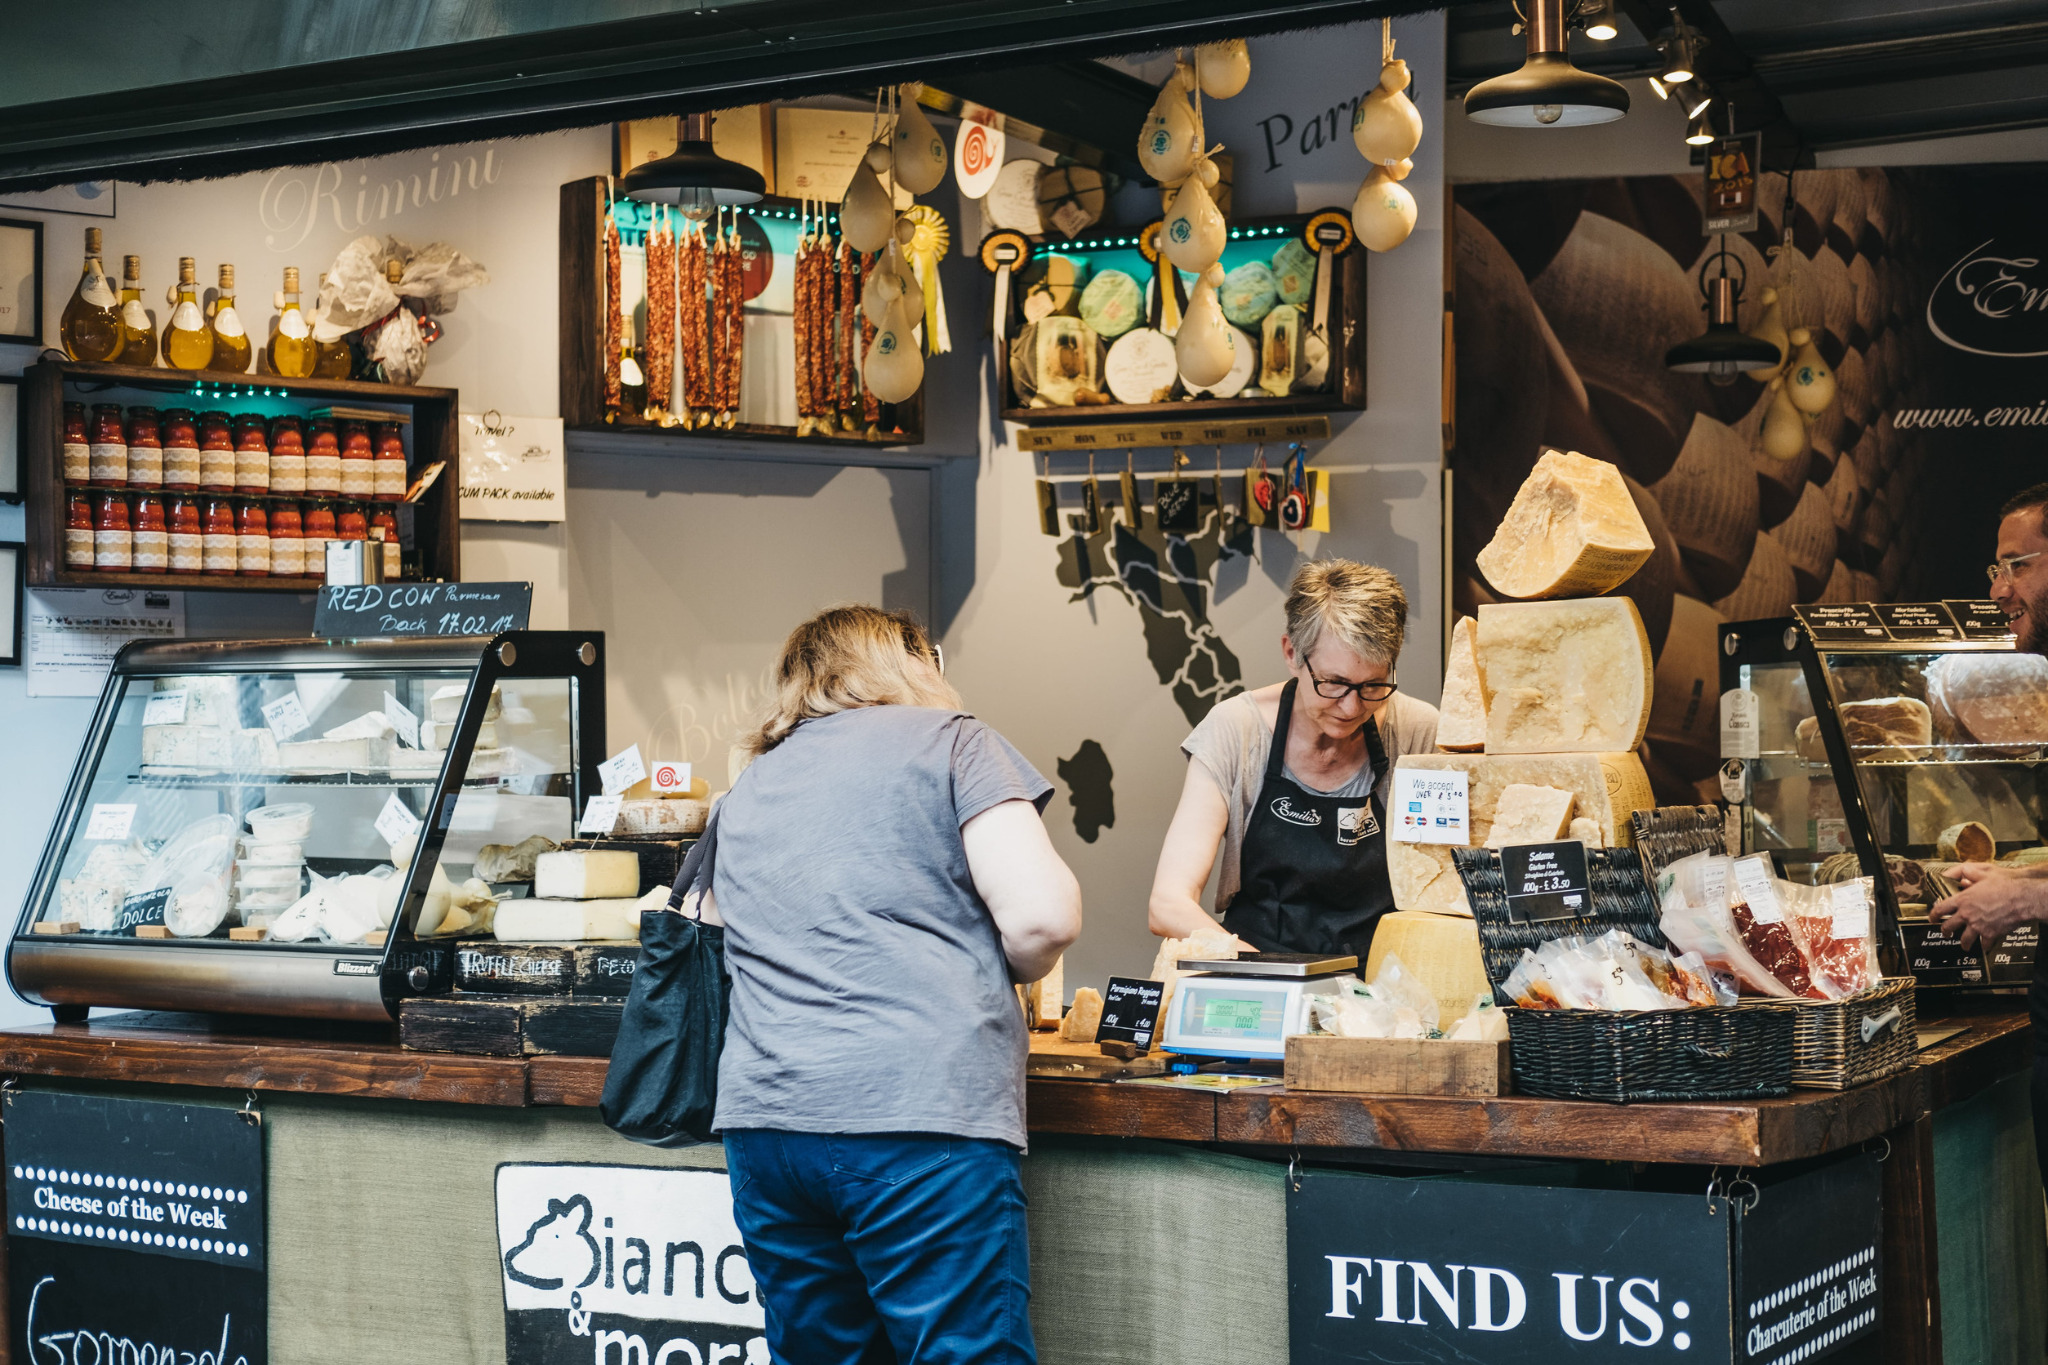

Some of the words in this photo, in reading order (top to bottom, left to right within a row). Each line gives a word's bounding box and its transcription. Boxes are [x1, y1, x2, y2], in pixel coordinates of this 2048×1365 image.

[1256, 70, 1421, 174] Par
[258, 139, 503, 253] Rimini
[1032, 436, 1053, 446] SUN
[1074, 433, 1096, 444] MON
[1116, 432, 1136, 442] TUE
[1160, 430, 1184, 441] WED
[1203, 428, 1227, 439] THU
[1247, 426, 1267, 437] FRI
[482, 488, 510, 499] PACK
[512, 488, 555, 501] available
[328, 585, 383, 612] RED
[388, 587, 440, 609] COW
[445, 585, 500, 602] Parmesan
[438, 612, 513, 634] 17.02.17
[1413, 779, 1425, 789] We
[1428, 781, 1454, 792] accept
[1416, 790, 1431, 799] OVER
[1529, 851, 1555, 862] Salame
[1523, 882, 1539, 894] 100g
[1551, 877, 1571, 889] 3.50
[121, 905, 163, 930] DOLCE
[458, 951, 515, 978] TRUFFLE
[1914, 958, 1931, 968] 100g
[1962, 956, 1977, 965] 5.00
[1995, 954, 2011, 964] 100g
[1110, 984, 1138, 996] Parmigiano
[1138, 987, 1161, 998] Reggiano
[1105, 1014, 1119, 1027] 100g
[1140, 1018, 1151, 1028] 4.00
[34, 1187, 102, 1215] Cheese
[107, 1196, 129, 1217] of
[131, 1198, 164, 1222] the
[167, 1202, 228, 1230] Week
[1324, 1254, 1527, 1332] FIND
[1551, 1272, 1691, 1351] US:
[1747, 1299, 1815, 1357] Charcuterie
[1817, 1289, 1829, 1321] of
[1829, 1285, 1847, 1315] the
[1847, 1267, 1877, 1304] Week
[568, 1309, 591, 1337] &
